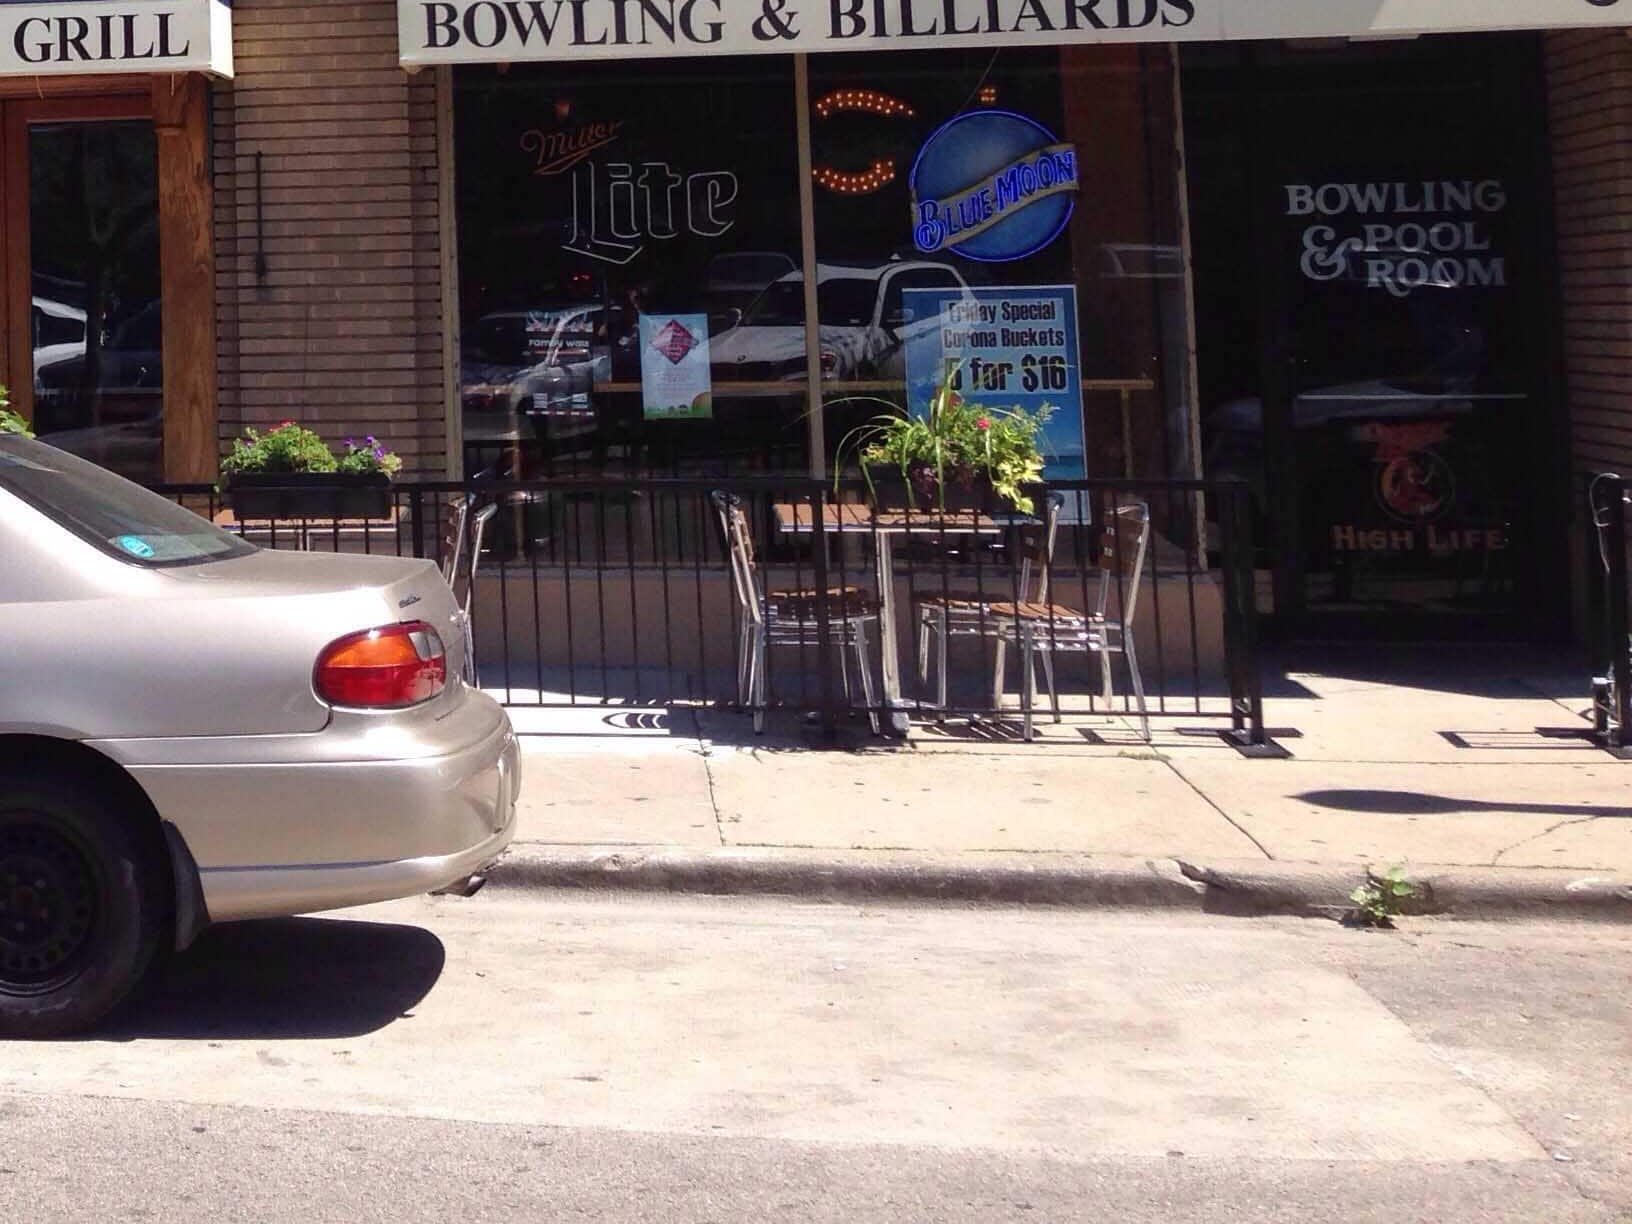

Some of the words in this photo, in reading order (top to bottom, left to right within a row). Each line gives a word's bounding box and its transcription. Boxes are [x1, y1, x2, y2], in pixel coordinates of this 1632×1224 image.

[13, 12, 190, 62] GRILL
[560, 161, 738, 264] Lite
[1283, 181, 1507, 216] BOWLING
[1300, 225, 1363, 281] &
[1362, 222, 1490, 253] POOL
[1365, 257, 1507, 297] ROOM
[1002, 300, 1056, 323] Special
[944, 329, 997, 349] Corona
[1002, 327, 1065, 347] Buckets
